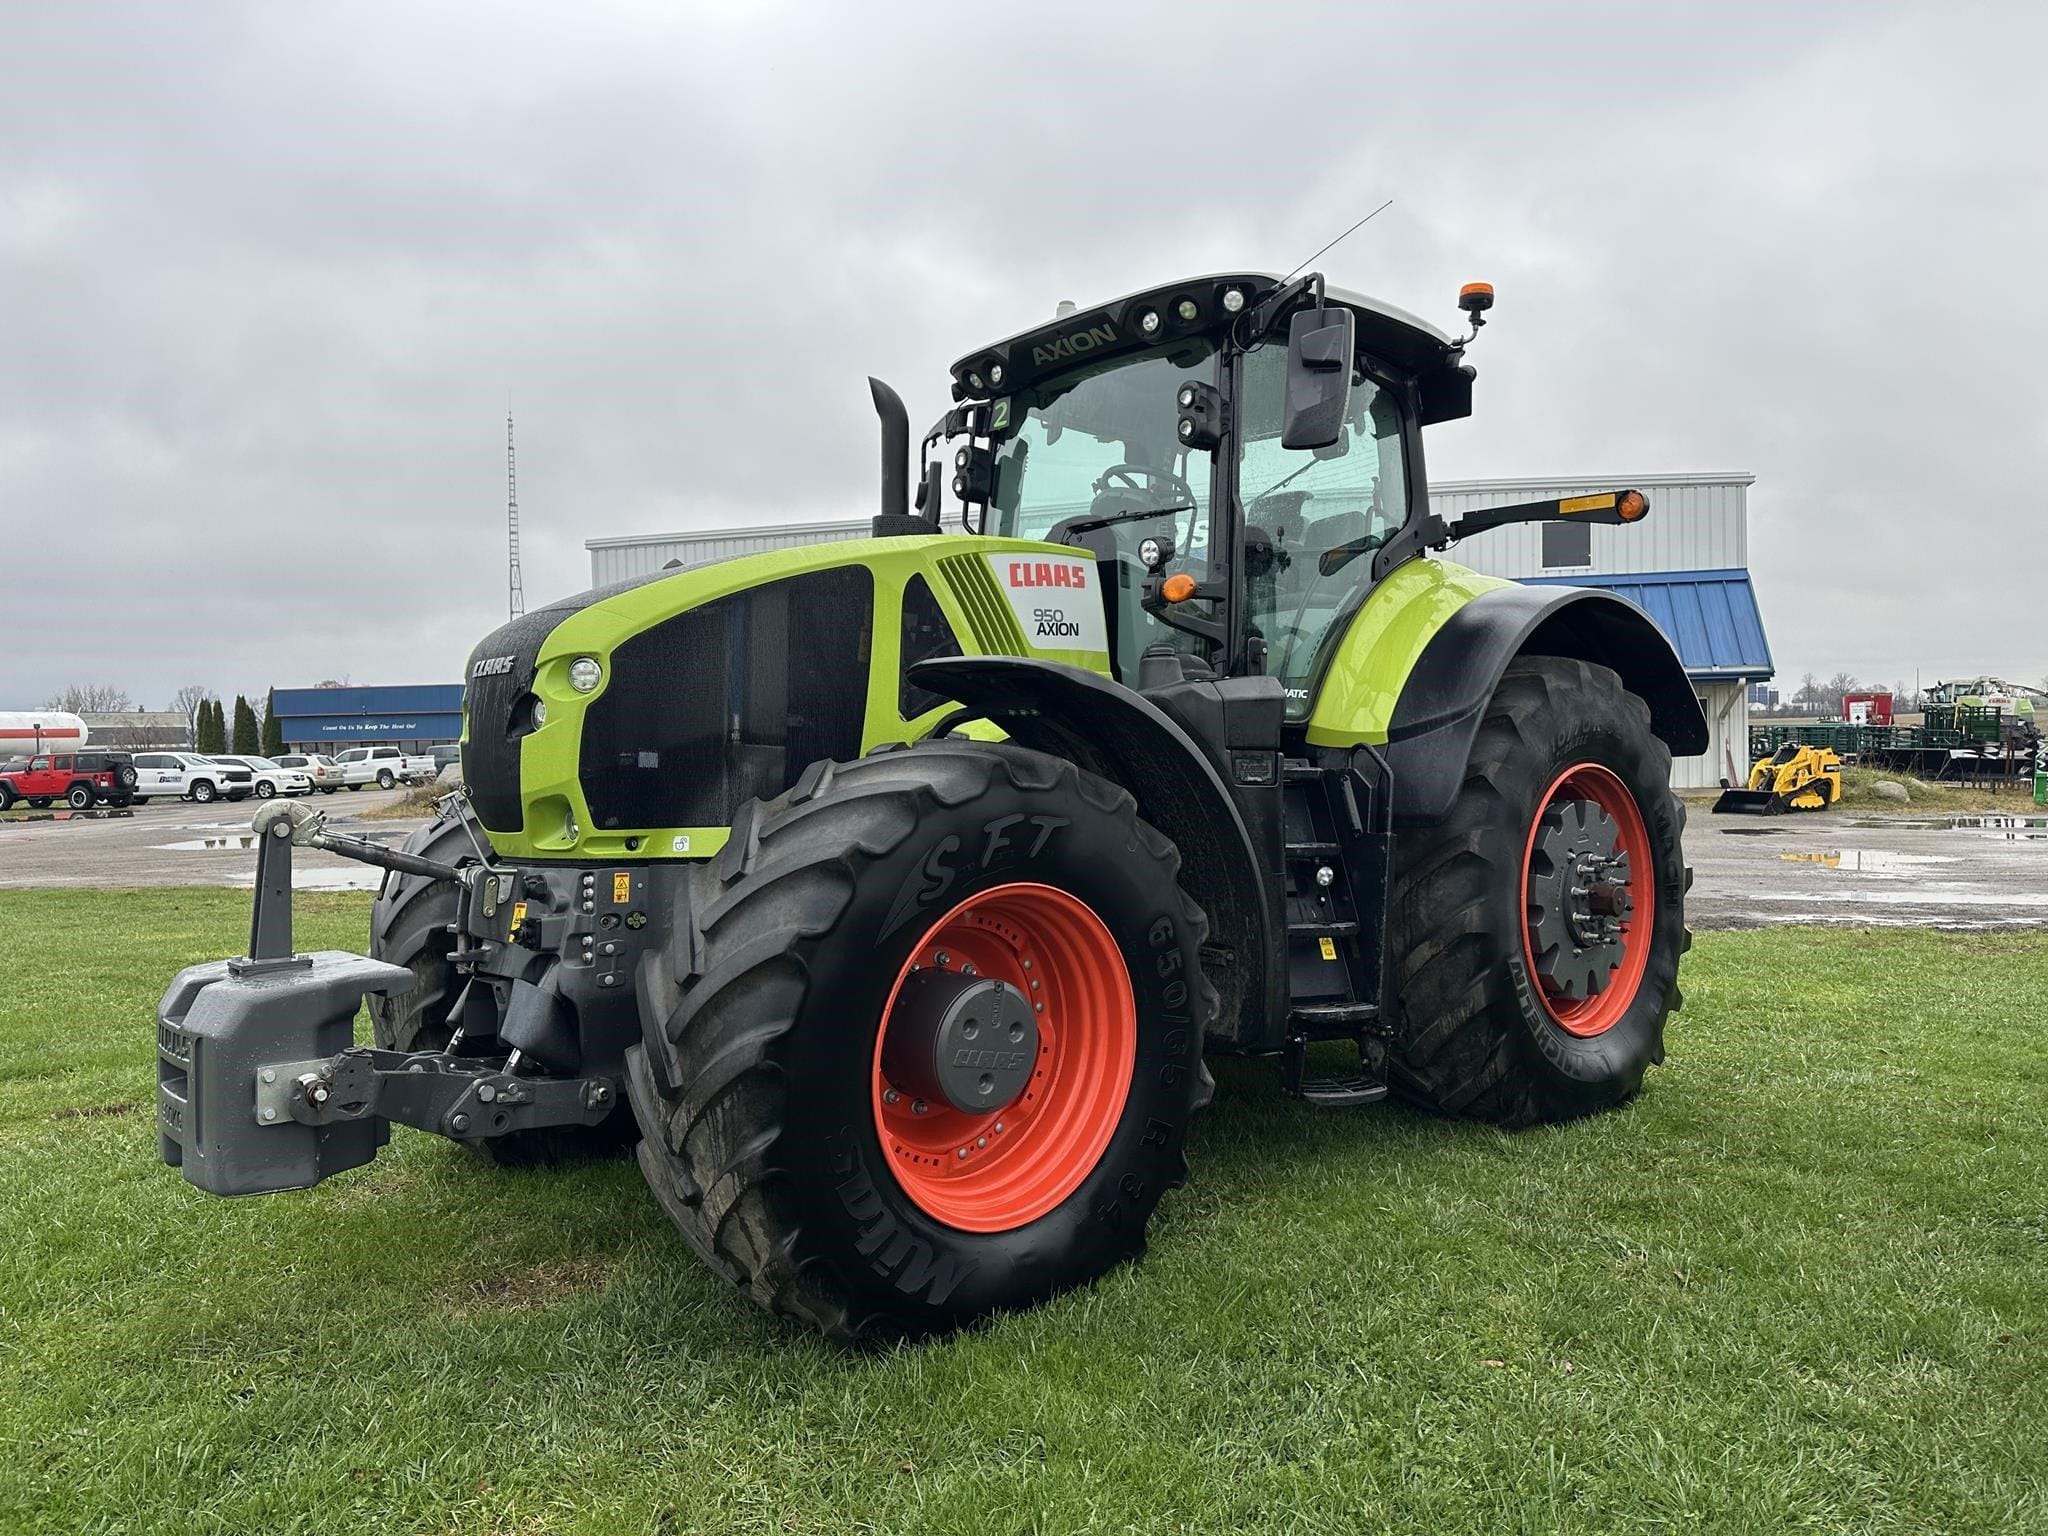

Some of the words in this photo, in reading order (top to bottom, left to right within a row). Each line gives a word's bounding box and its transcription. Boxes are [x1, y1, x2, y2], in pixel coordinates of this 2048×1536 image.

[1032, 323, 1117, 366] AXION
[993, 401, 1008, 427] 2
[1009, 563, 1085, 588] CLAAS
[1033, 608, 1063, 622] 950
[1036, 622, 1079, 636] AXION
[472, 655, 516, 678] CLAAS
[1508, 960, 1585, 1080] MICHELIN
[953, 1048, 1027, 1070] CLAAS
[824, 1122, 981, 1307] Mitas
